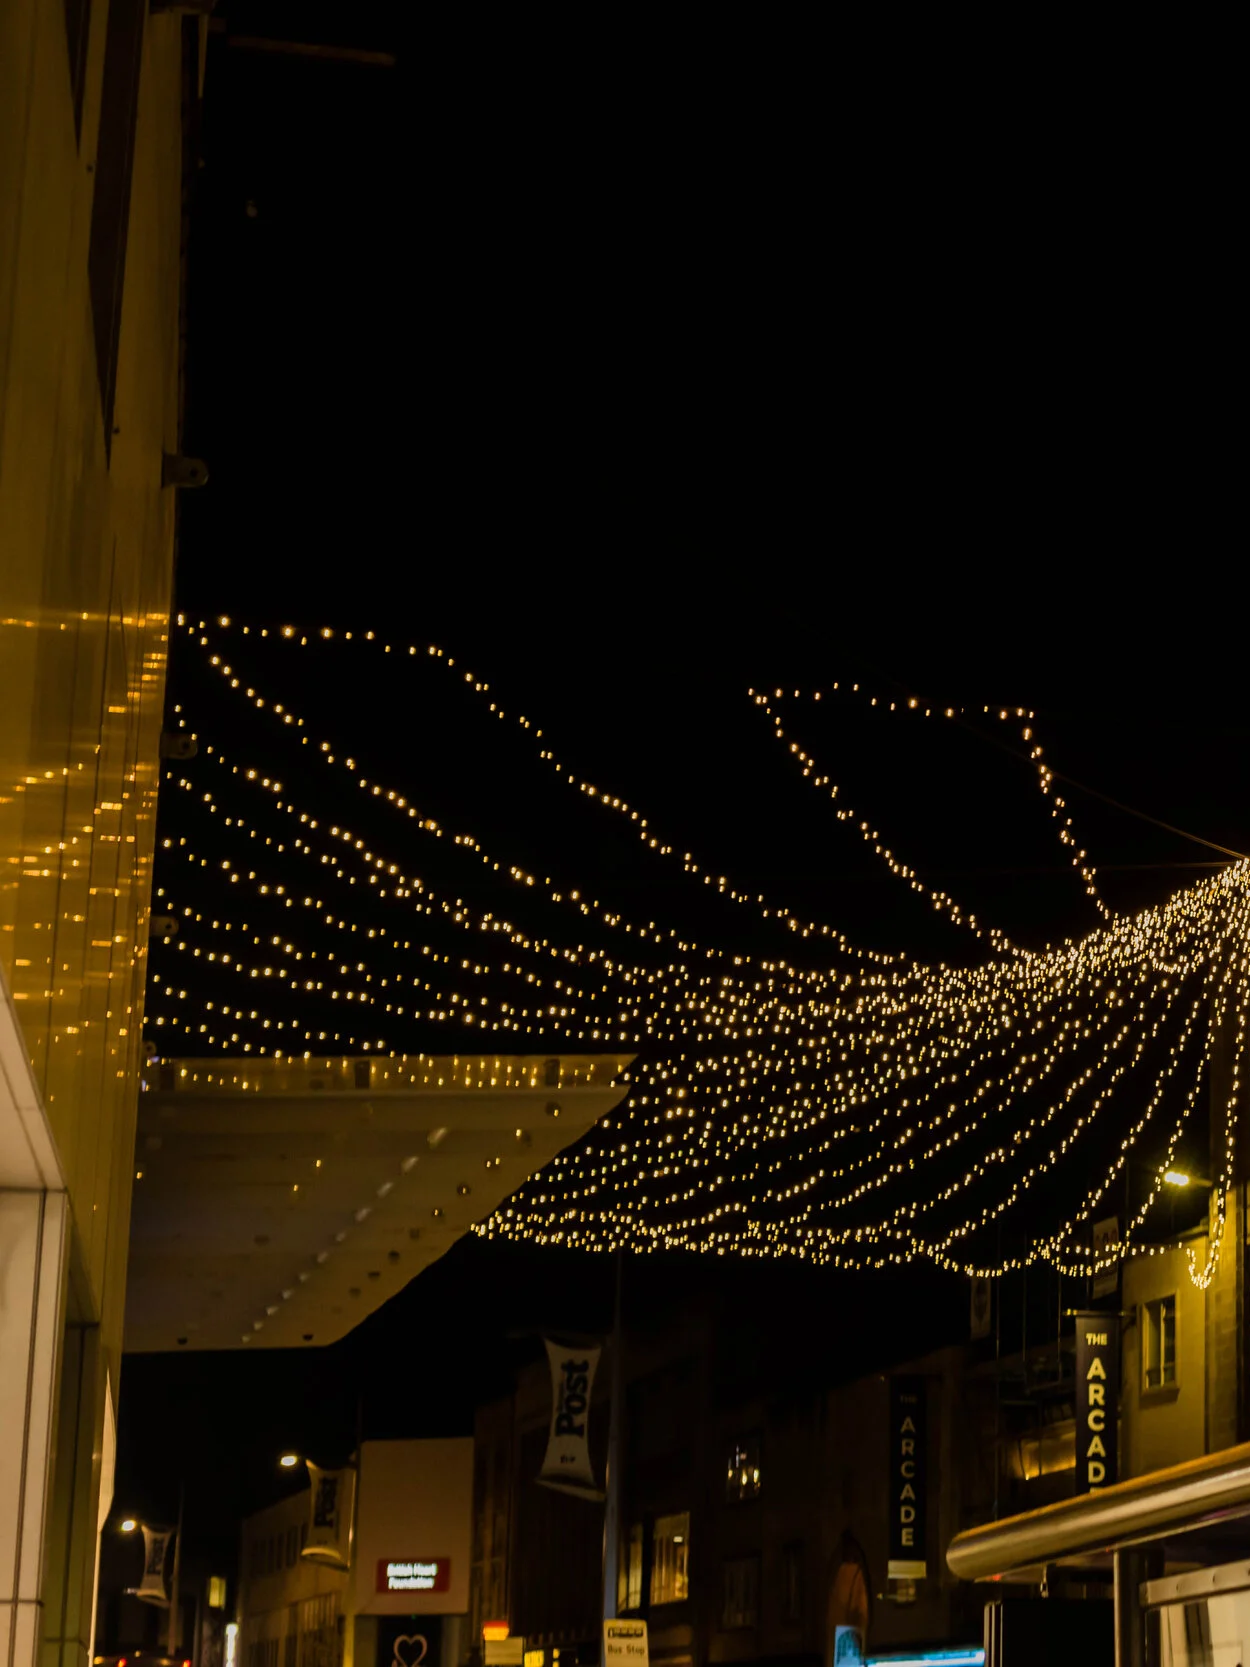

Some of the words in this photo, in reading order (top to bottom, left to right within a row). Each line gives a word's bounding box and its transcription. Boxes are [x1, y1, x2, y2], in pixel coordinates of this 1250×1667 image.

[1085, 1332, 1108, 1346] THE
[555, 1359, 590, 1438] Post
[1086, 1356, 1107, 1493] ARCAD
[900, 1414, 917, 1547] ARCADE
